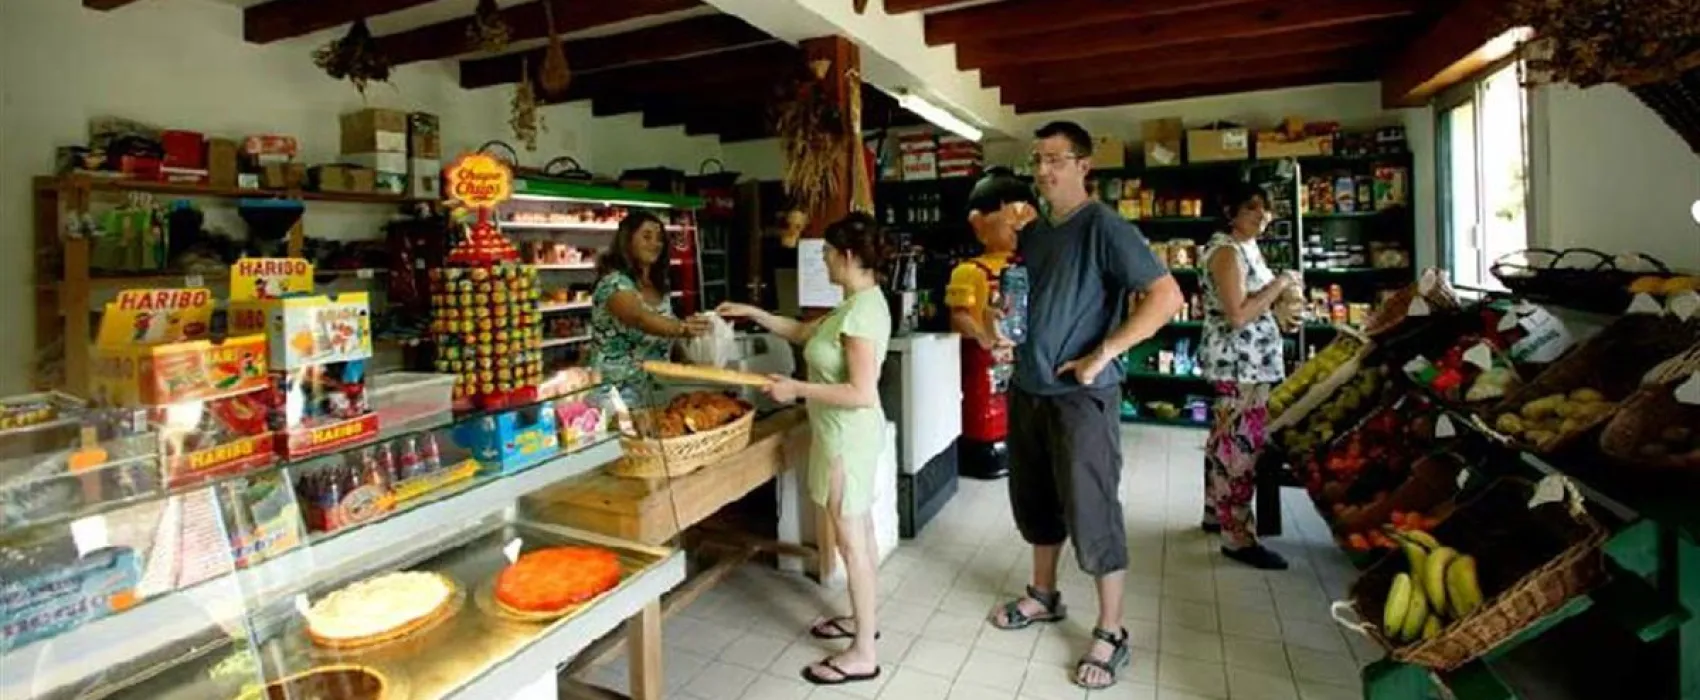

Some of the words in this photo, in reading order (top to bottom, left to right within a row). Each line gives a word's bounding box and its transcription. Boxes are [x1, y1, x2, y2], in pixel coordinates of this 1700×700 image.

[239, 261, 306, 276] HARIBO
[120, 290, 207, 310] HARIBO
[189, 439, 254, 469] HARIBO
